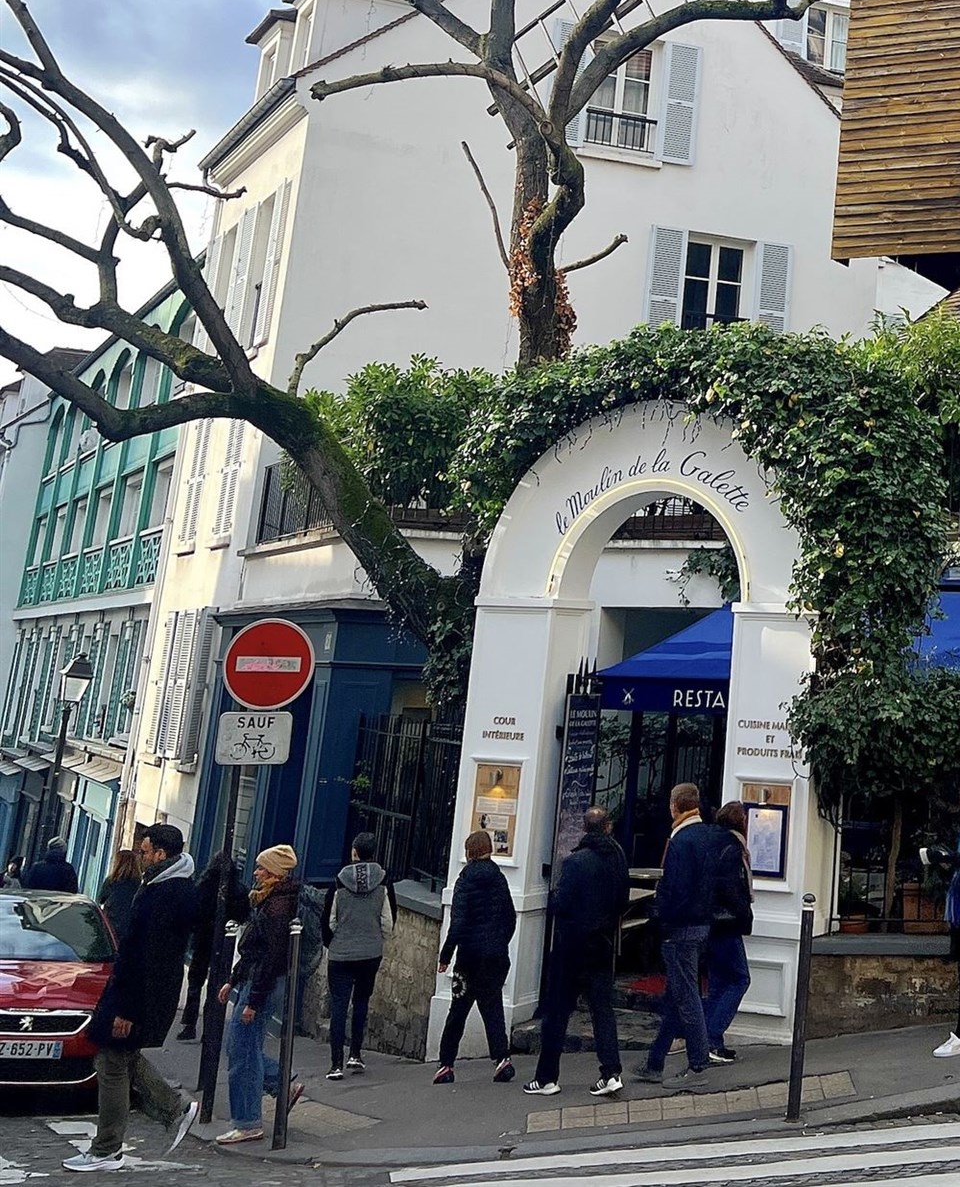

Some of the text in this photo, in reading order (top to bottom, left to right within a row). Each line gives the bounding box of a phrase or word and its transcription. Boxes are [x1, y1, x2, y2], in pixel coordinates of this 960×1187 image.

[555, 448, 750, 535] le Moulin de la Galette
[673, 689, 726, 708] RESTA
[237, 717, 276, 729] SAUF
[493, 716, 516, 726] COUR
[738, 719, 771, 730] CUISINE
[482, 730, 525, 742] INTÉRIEURE
[765, 735, 775, 744] ET
[737, 746, 778, 758] PRODUITS
